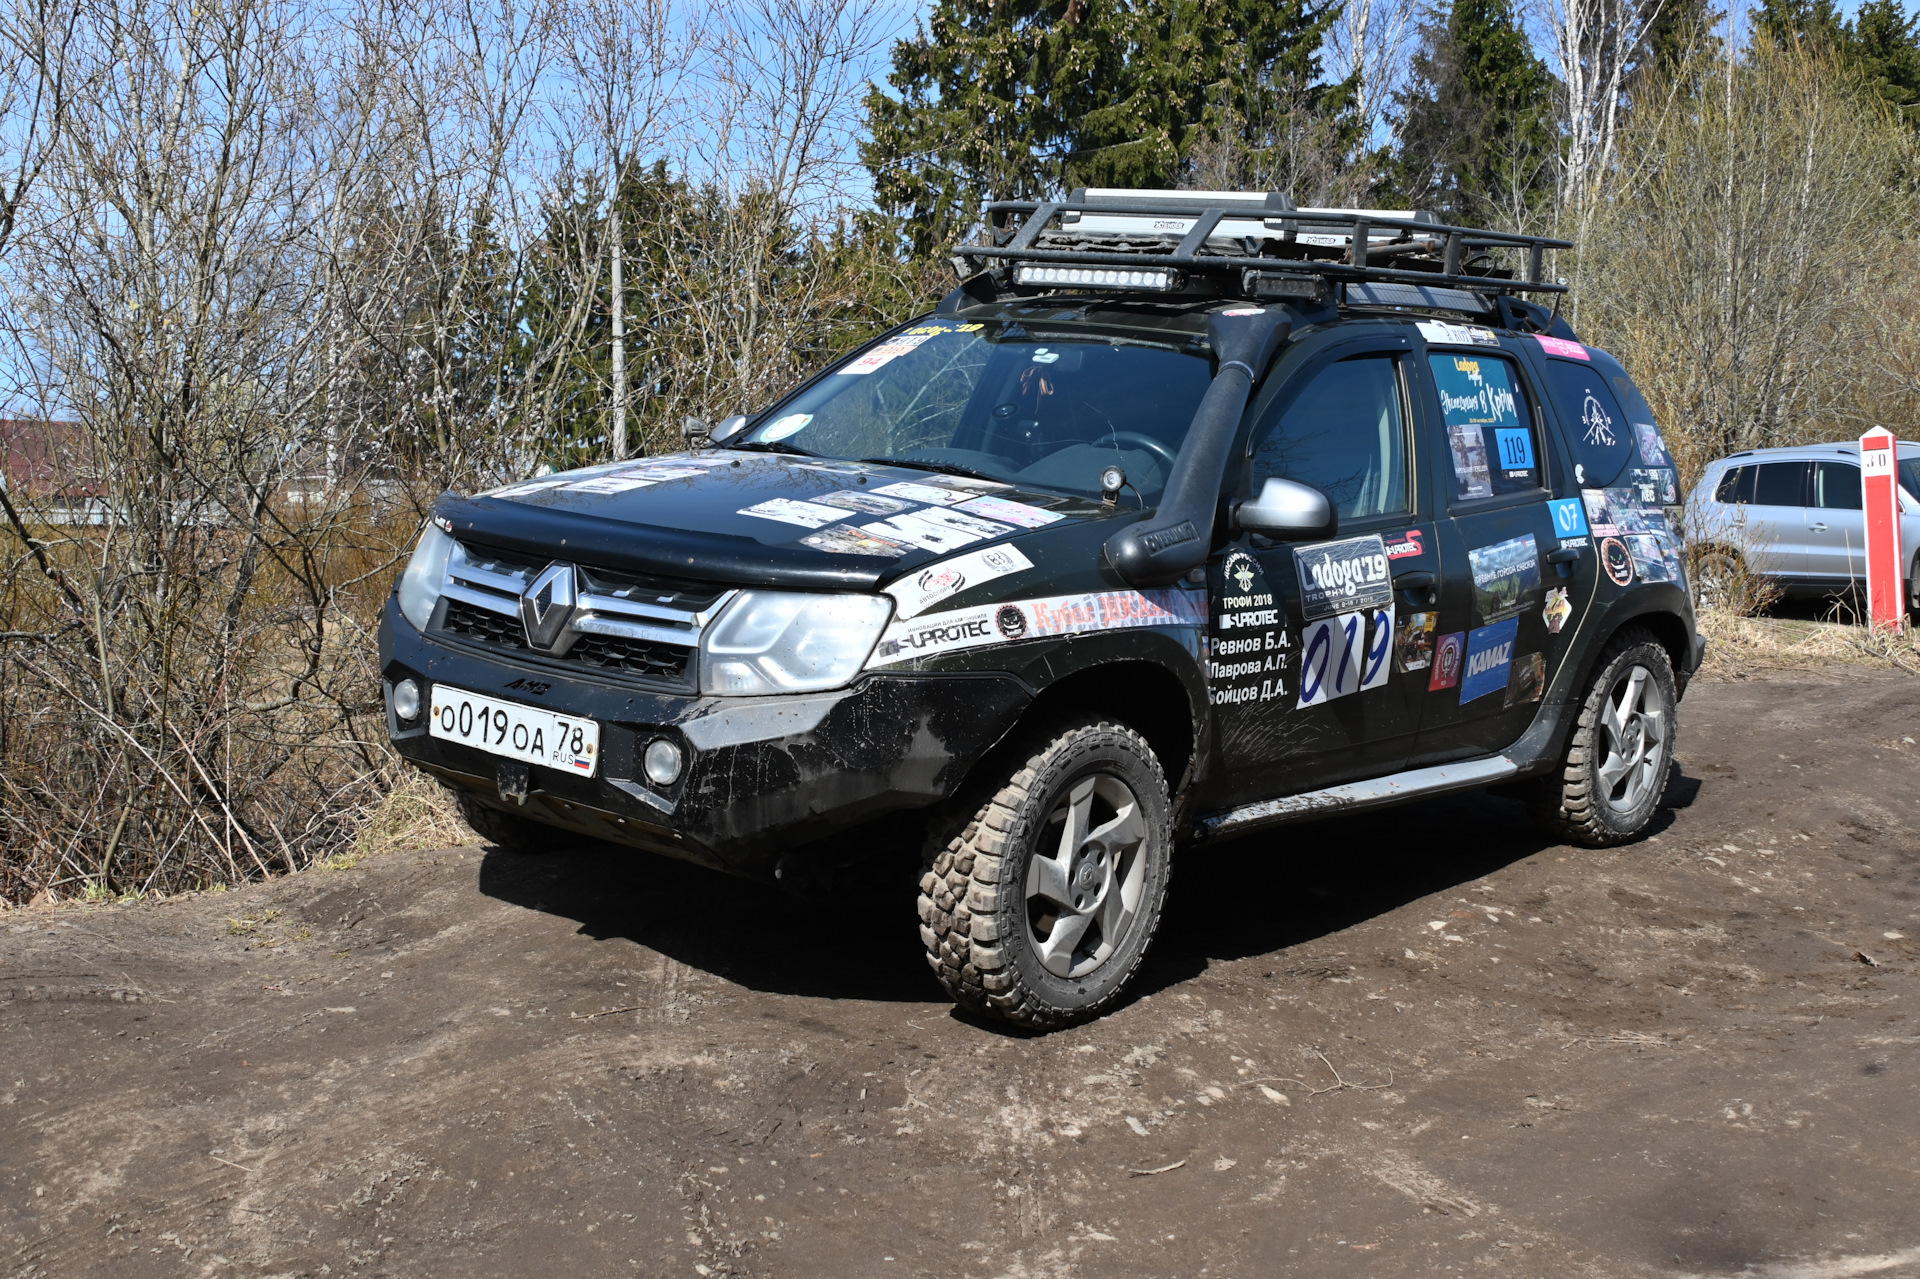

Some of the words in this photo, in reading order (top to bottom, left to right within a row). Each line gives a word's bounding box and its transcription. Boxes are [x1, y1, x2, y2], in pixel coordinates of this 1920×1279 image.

[1504, 436, 1526, 464] 119
[1866, 453, 1887, 468] 30
[1558, 503, 1578, 532] 07
[1222, 595, 1253, 609] ТРОФИ
[1253, 593, 1273, 606] 2018
[1305, 588, 1346, 602] TROPHY
[1031, 601, 1095, 632] Кубок
[1210, 637, 1261, 656] Ревнов
[1264, 630, 1291, 650] Б.А.
[1209, 660, 1261, 680] Лаврова
[1263, 653, 1288, 672] А.П.
[1301, 611, 1390, 703] 019
[1467, 641, 1512, 678] KAMAZ
[1207, 684, 1258, 705] Бойцов
[1260, 678, 1288, 702] Д.А.
[557, 721, 584, 755] 78
[552, 750, 574, 765] RUS
